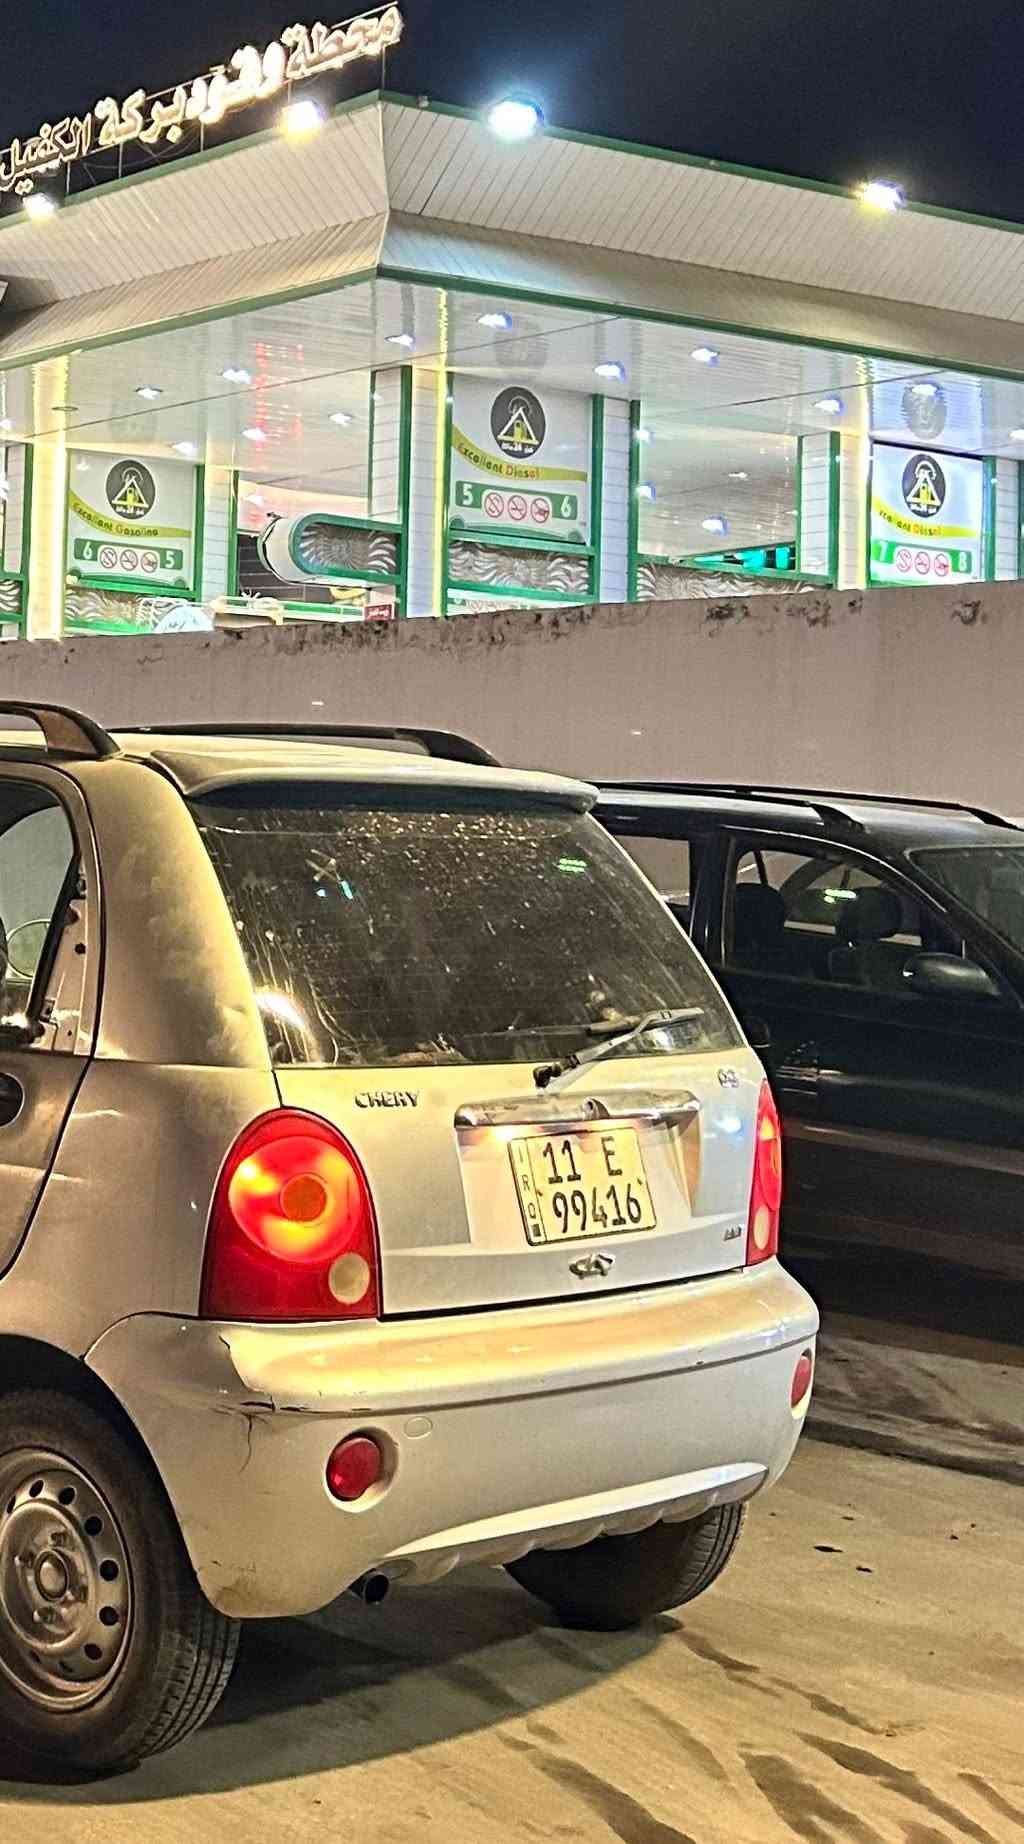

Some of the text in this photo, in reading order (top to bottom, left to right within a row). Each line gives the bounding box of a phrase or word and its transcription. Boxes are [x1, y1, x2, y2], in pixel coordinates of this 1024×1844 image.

[280, 6, 403, 79] محطة
[185, 41, 285, 123] وقود
[96, 87, 186, 145] بركة
[462, 484, 474, 506] 5
[560, 496, 573, 518] 6
[82, 541, 94, 560] 6
[164, 550, 176, 569] 5
[958, 551, 968, 573] 8
[354, 1090, 419, 1109] CHERY
[542, 1135, 624, 1185] 11 E
[551, 1182, 643, 1234] 99416
